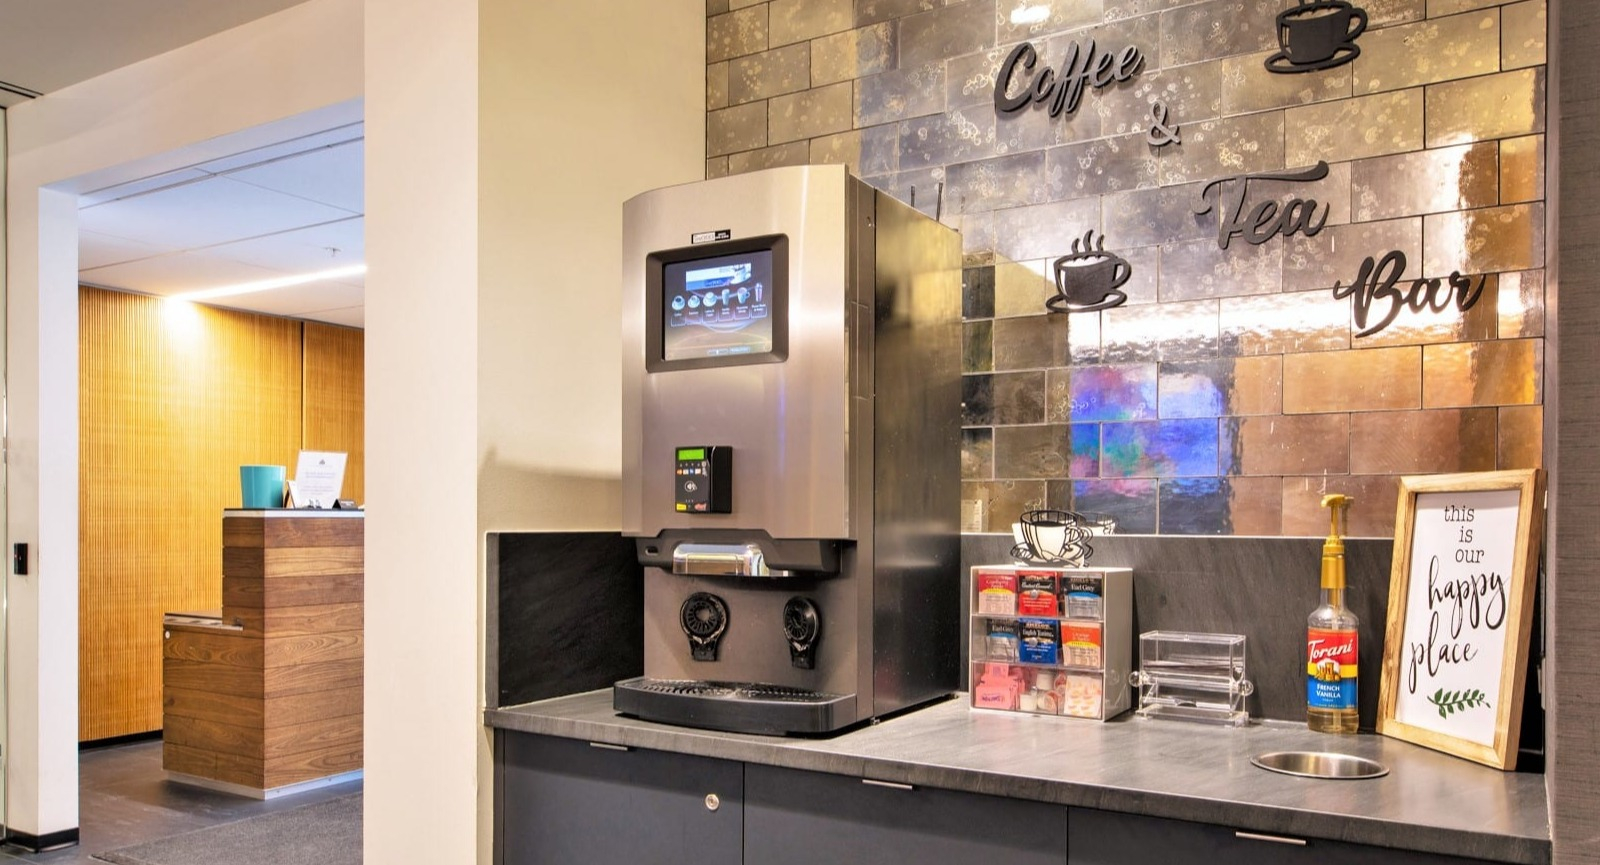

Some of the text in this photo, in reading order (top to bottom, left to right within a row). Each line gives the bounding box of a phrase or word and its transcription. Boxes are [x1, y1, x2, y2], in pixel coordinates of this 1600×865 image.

[994, 39, 1144, 118] Coffee
[1147, 102, 1180, 148] &
[1198, 160, 1330, 250] Tea
[1333, 250, 1486, 339] Bar
[1444, 505, 1475, 522] this
[1459, 526, 1473, 543] is
[1455, 547, 1485, 563] our
[1428, 555, 1509, 639] happy
[1308, 639, 1353, 663] Torani
[1408, 610, 1478, 694] place
[1316, 683, 1340, 691] FRENCH
[1316, 690, 1341, 699] VANILLA
